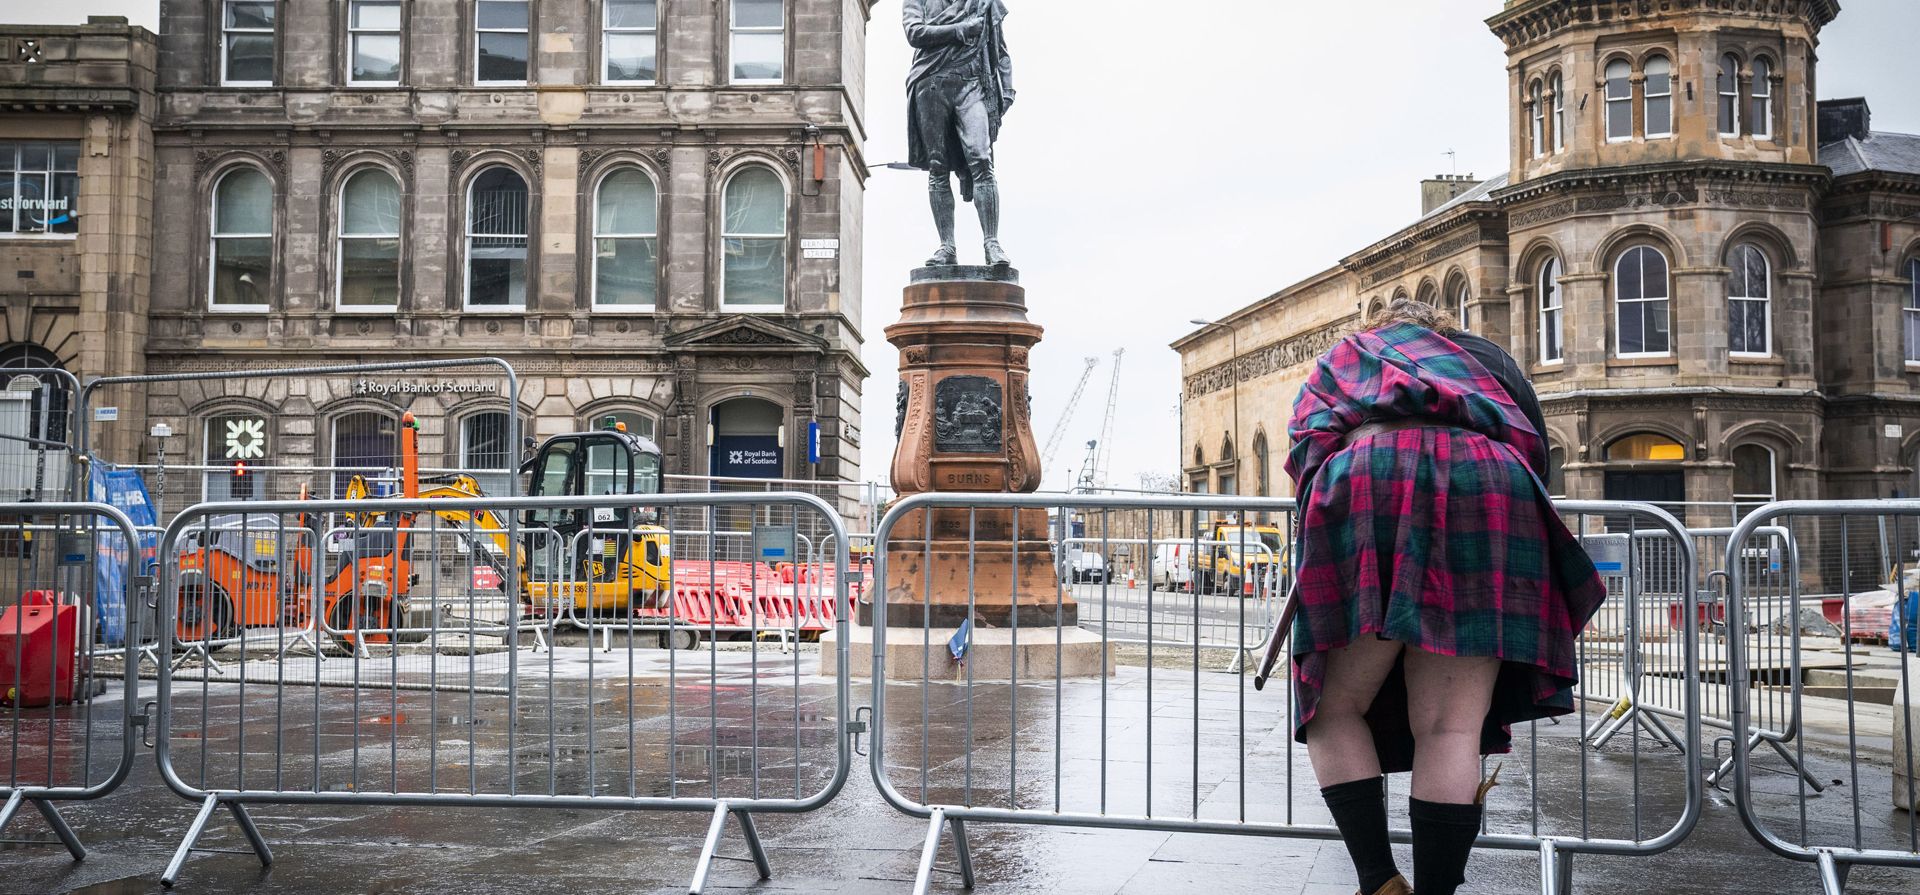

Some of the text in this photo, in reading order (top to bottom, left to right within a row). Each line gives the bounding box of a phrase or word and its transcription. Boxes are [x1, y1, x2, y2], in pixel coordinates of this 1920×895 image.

[18, 196, 68, 209] forward
[368, 381, 496, 395] Royal Bank of Scotland
[744, 450, 761, 458] Royal
[948, 474, 991, 484] BURNS
